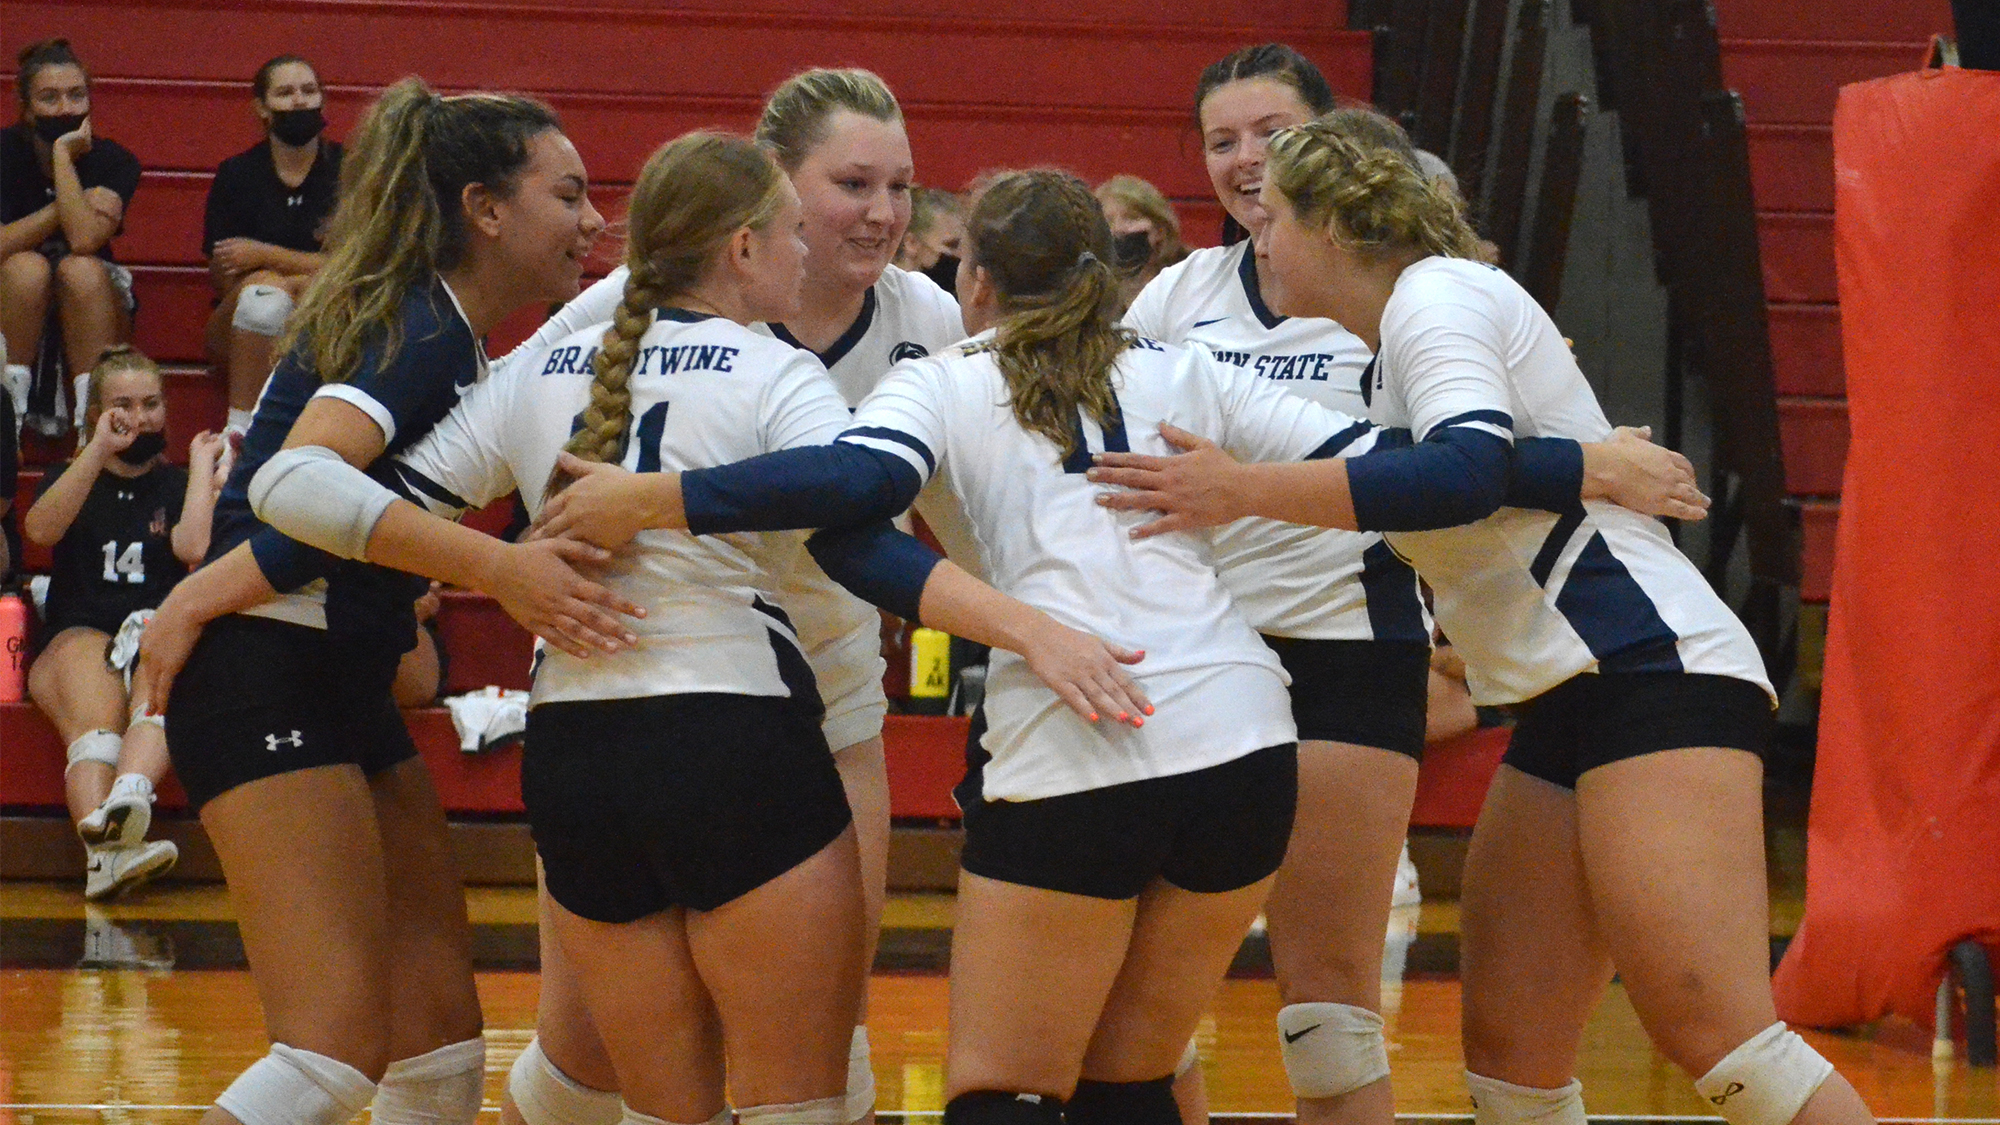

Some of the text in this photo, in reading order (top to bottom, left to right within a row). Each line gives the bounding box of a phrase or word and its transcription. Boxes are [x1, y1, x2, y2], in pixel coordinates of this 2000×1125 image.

[541, 345, 740, 376] BRAYWINE
[1253, 353, 1334, 382] STATE
[102, 540, 145, 583] 14
